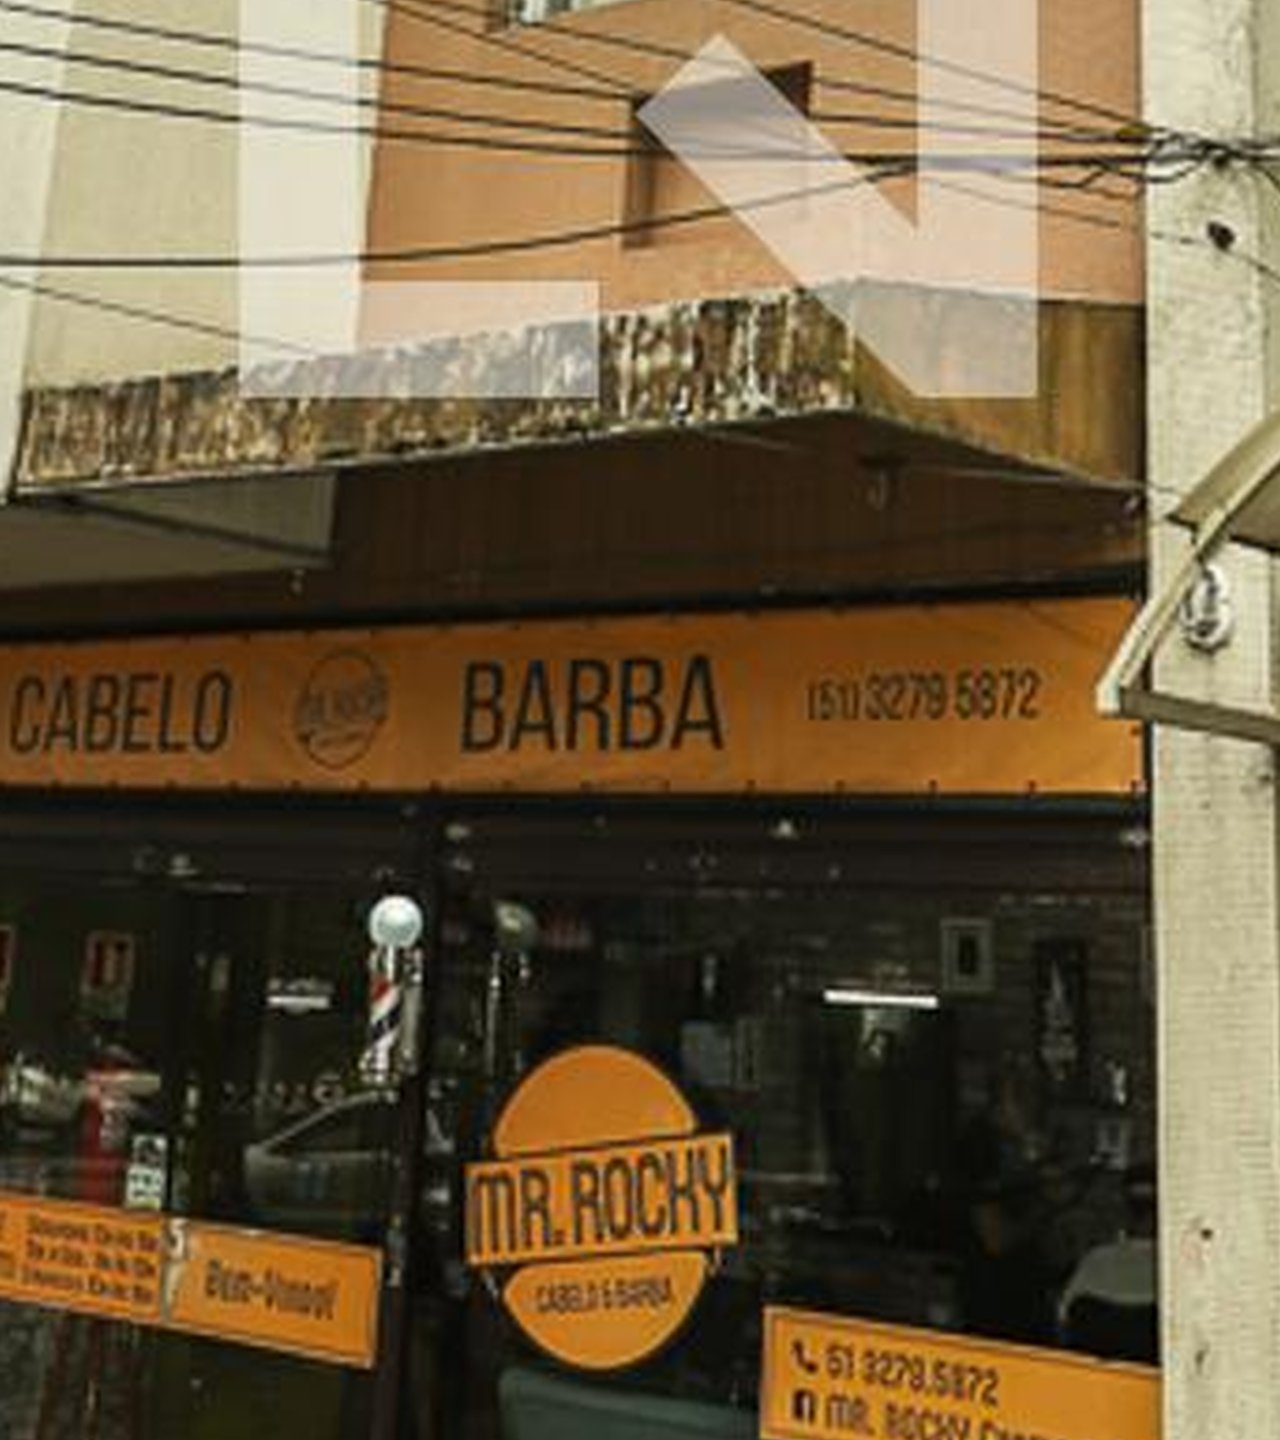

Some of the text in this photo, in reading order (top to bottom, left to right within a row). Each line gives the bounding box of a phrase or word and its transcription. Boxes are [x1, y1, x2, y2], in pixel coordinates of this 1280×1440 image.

[8, 667, 233, 757] CABELO
[460, 655, 725, 753] BARBA
[865, 671, 948, 722] 3279
[954, 666, 1042, 721] 5872
[825, 1393, 876, 1438] MR.
